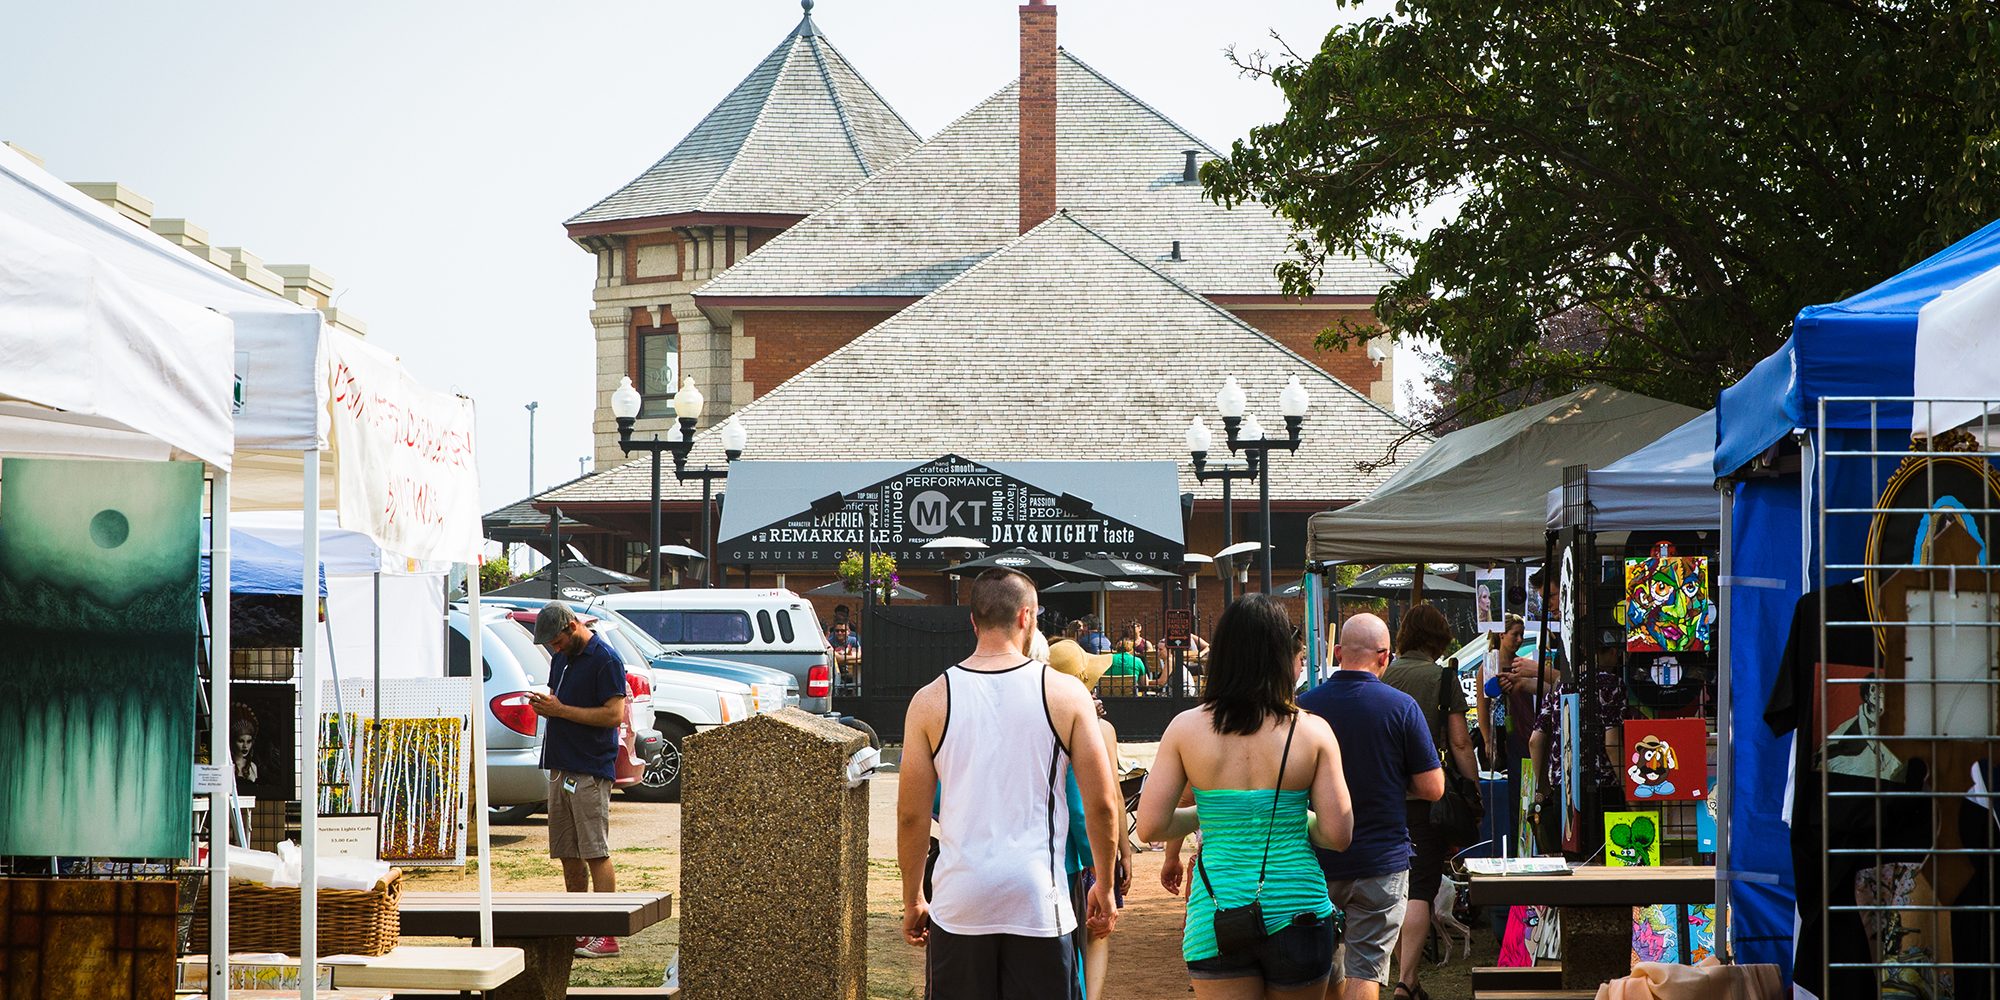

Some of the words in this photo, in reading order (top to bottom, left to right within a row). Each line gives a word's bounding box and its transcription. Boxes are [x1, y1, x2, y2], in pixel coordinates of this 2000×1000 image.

[950, 463, 975, 473] smooth
[905, 477, 1003, 487] PERFORMANCE
[992, 490, 1006, 521] choice
[1007, 483, 1017, 521] flavour
[1019, 487, 1027, 521] WORTH
[1029, 497, 1056, 507] PASSION
[814, 512, 879, 528] EXPERIENE
[891, 481, 905, 543] genuine
[914, 499, 987, 527] MKT
[1103, 527, 1135, 543] taste
[733, 551, 819, 560] GENUINE
